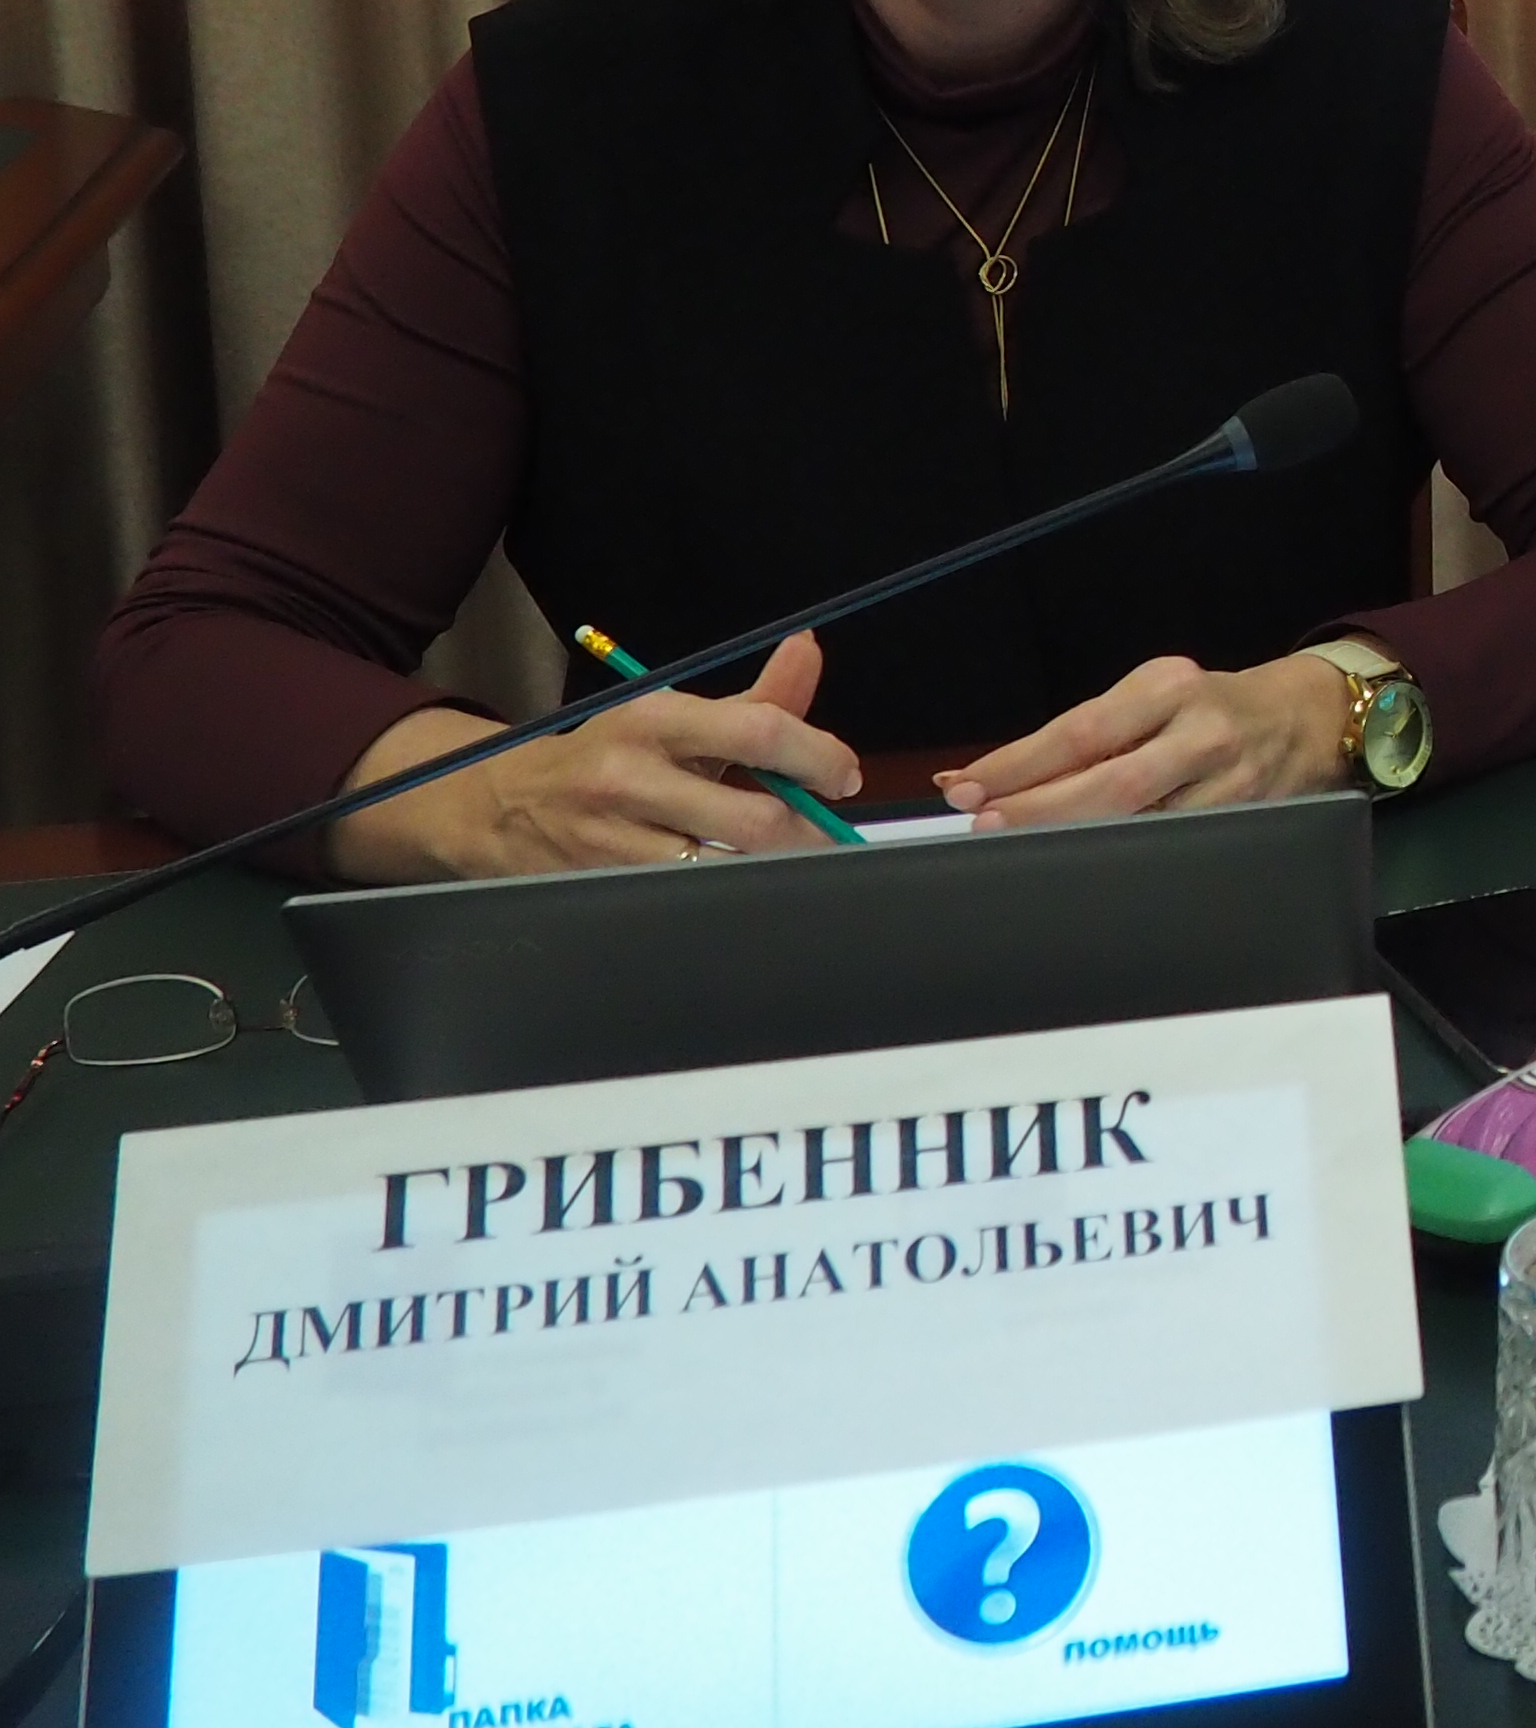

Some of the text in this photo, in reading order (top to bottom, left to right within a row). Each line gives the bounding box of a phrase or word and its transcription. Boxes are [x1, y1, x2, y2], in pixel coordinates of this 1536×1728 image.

[371, 1090, 1152, 1252] ГРИБЕННИК
[233, 1193, 1273, 1378] ДМИТРИЙ АНАТОЛЬЕВИЧ
[1064, 1623, 1219, 1666] ПОМОЩЬ
[449, 1696, 573, 1728] ПАПКА
